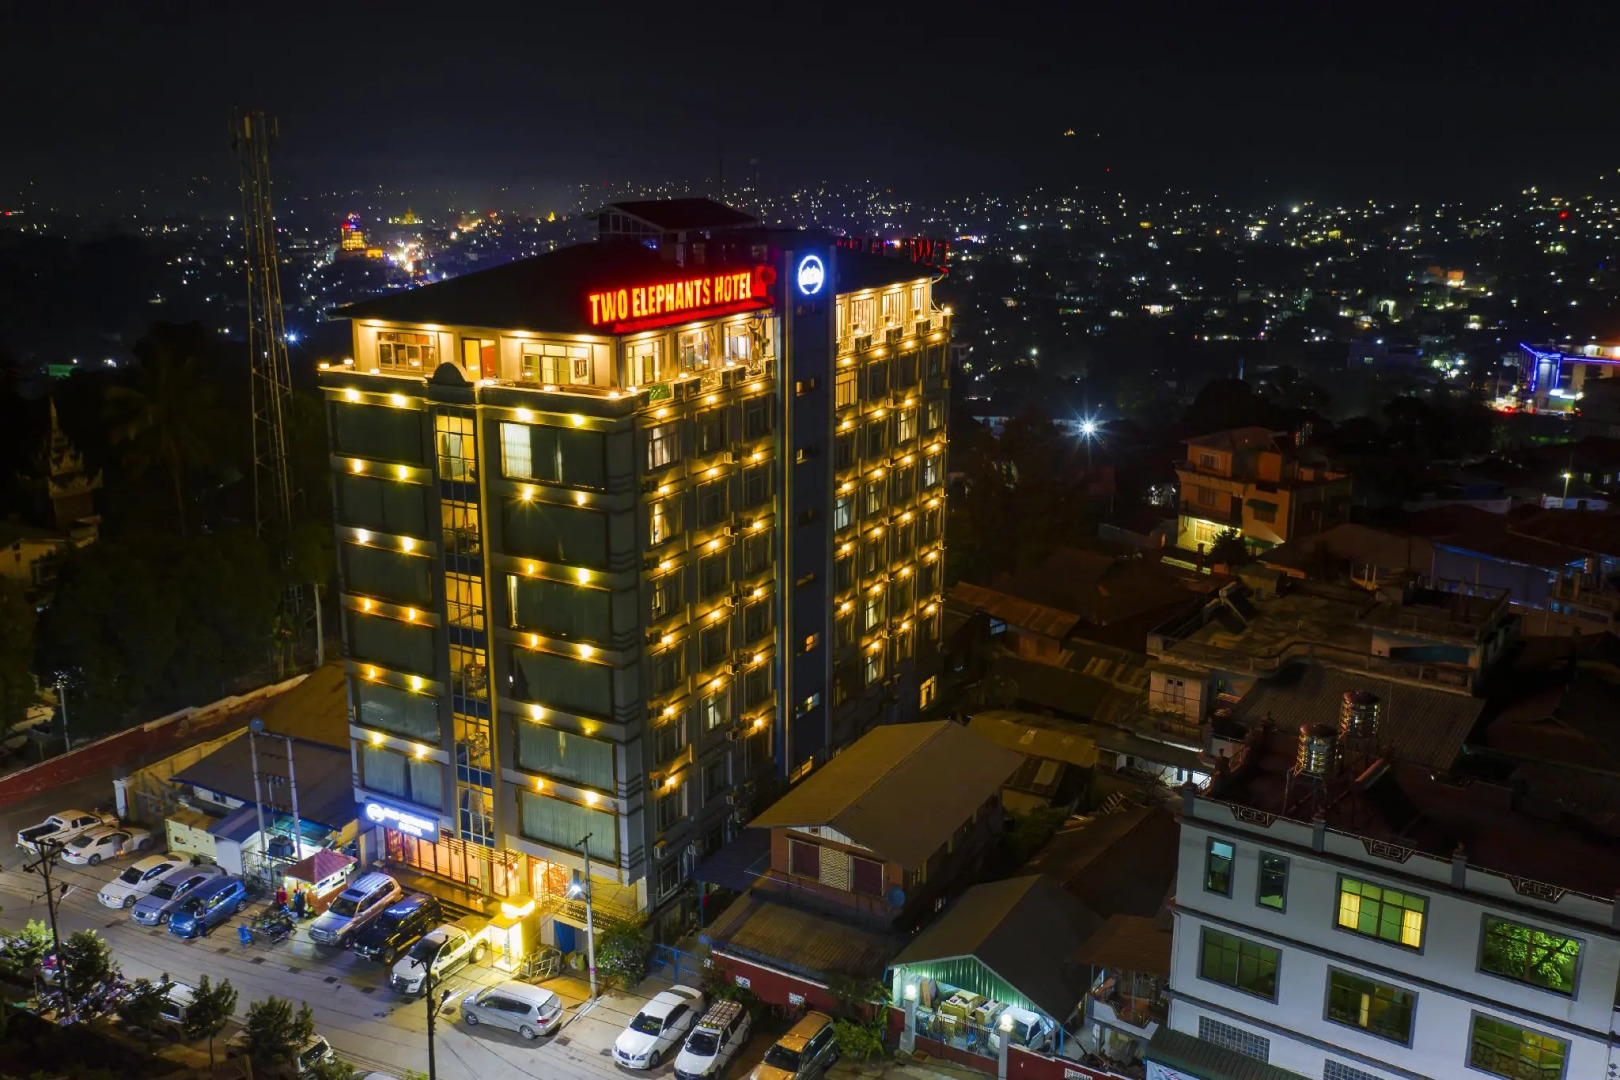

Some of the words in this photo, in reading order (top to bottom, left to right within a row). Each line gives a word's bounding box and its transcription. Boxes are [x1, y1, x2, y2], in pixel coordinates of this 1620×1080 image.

[590, 290, 627, 324] TWO
[632, 278, 710, 317] ELEPHANTS
[715, 273, 752, 303] HOTEL
